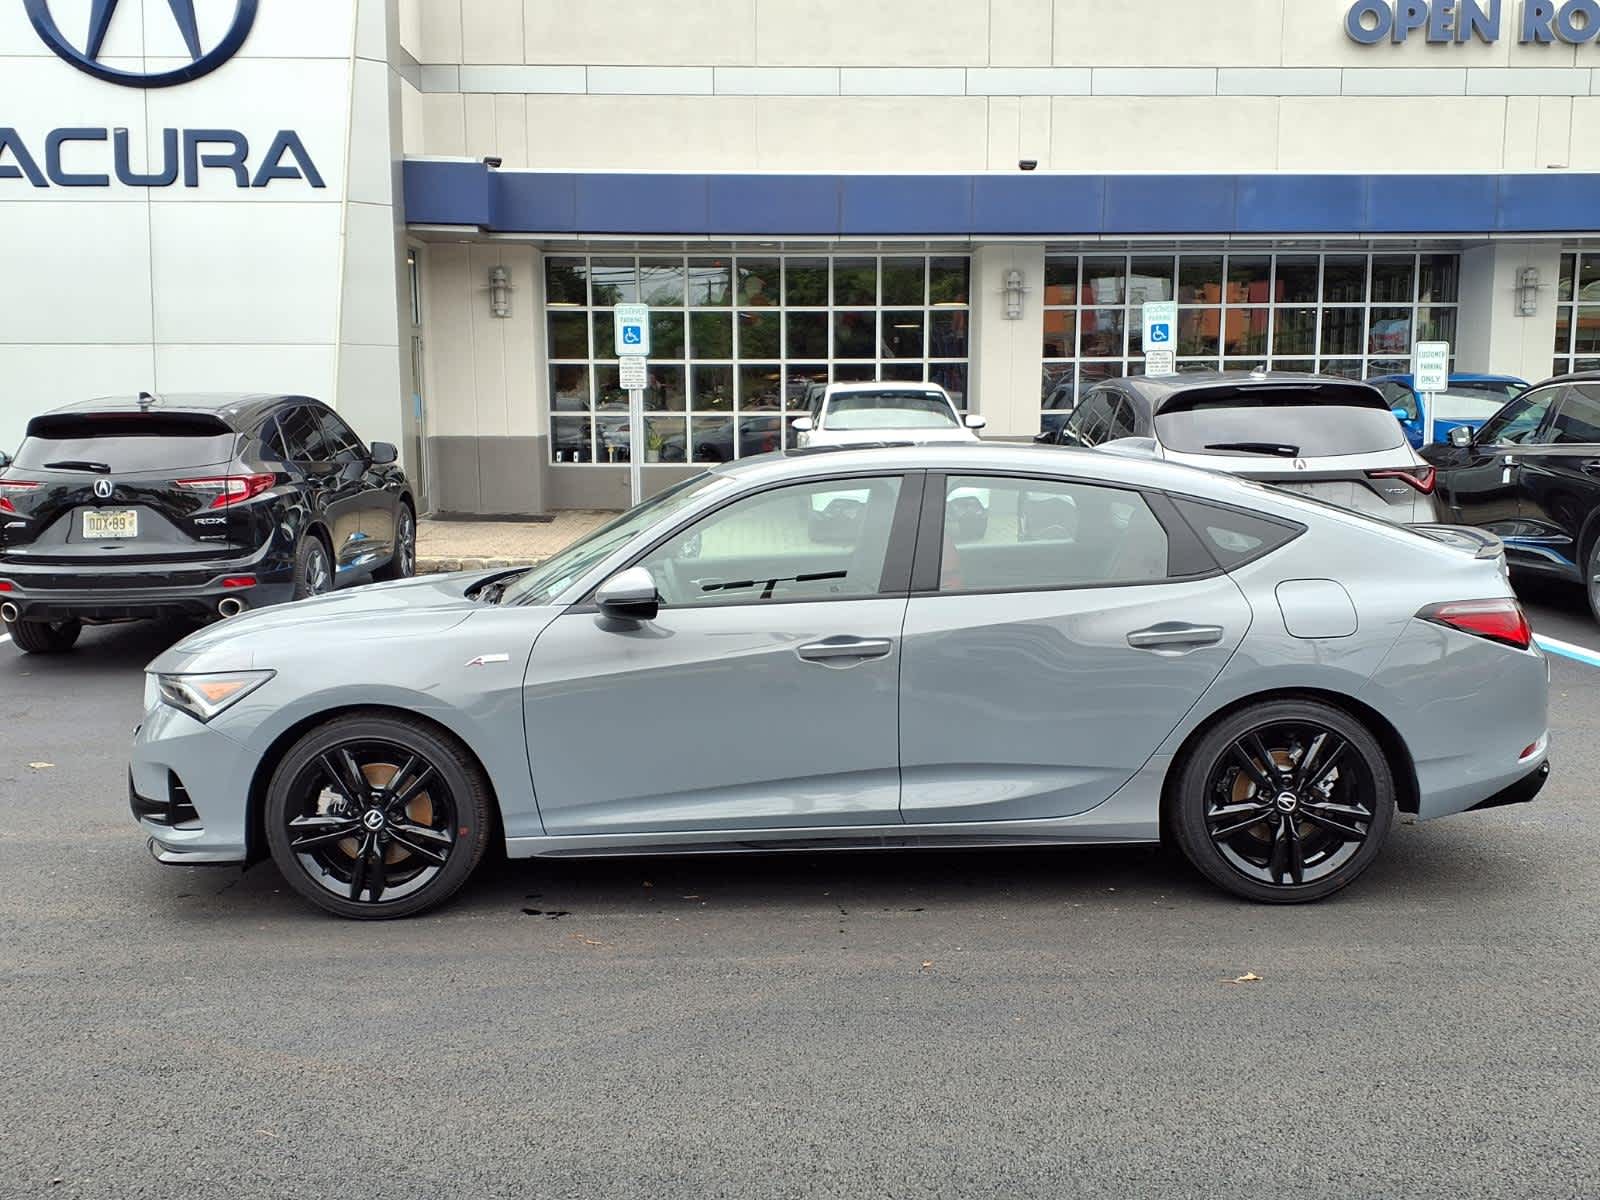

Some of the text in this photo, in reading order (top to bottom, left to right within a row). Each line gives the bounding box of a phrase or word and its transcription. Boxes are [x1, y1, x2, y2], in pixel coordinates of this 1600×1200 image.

[1344, 0, 1600, 44] OPEN RO
[0, 127, 327, 188] ACURA
[1421, 375, 1441, 383] ONLY
[193, 517, 227, 525] RDX
